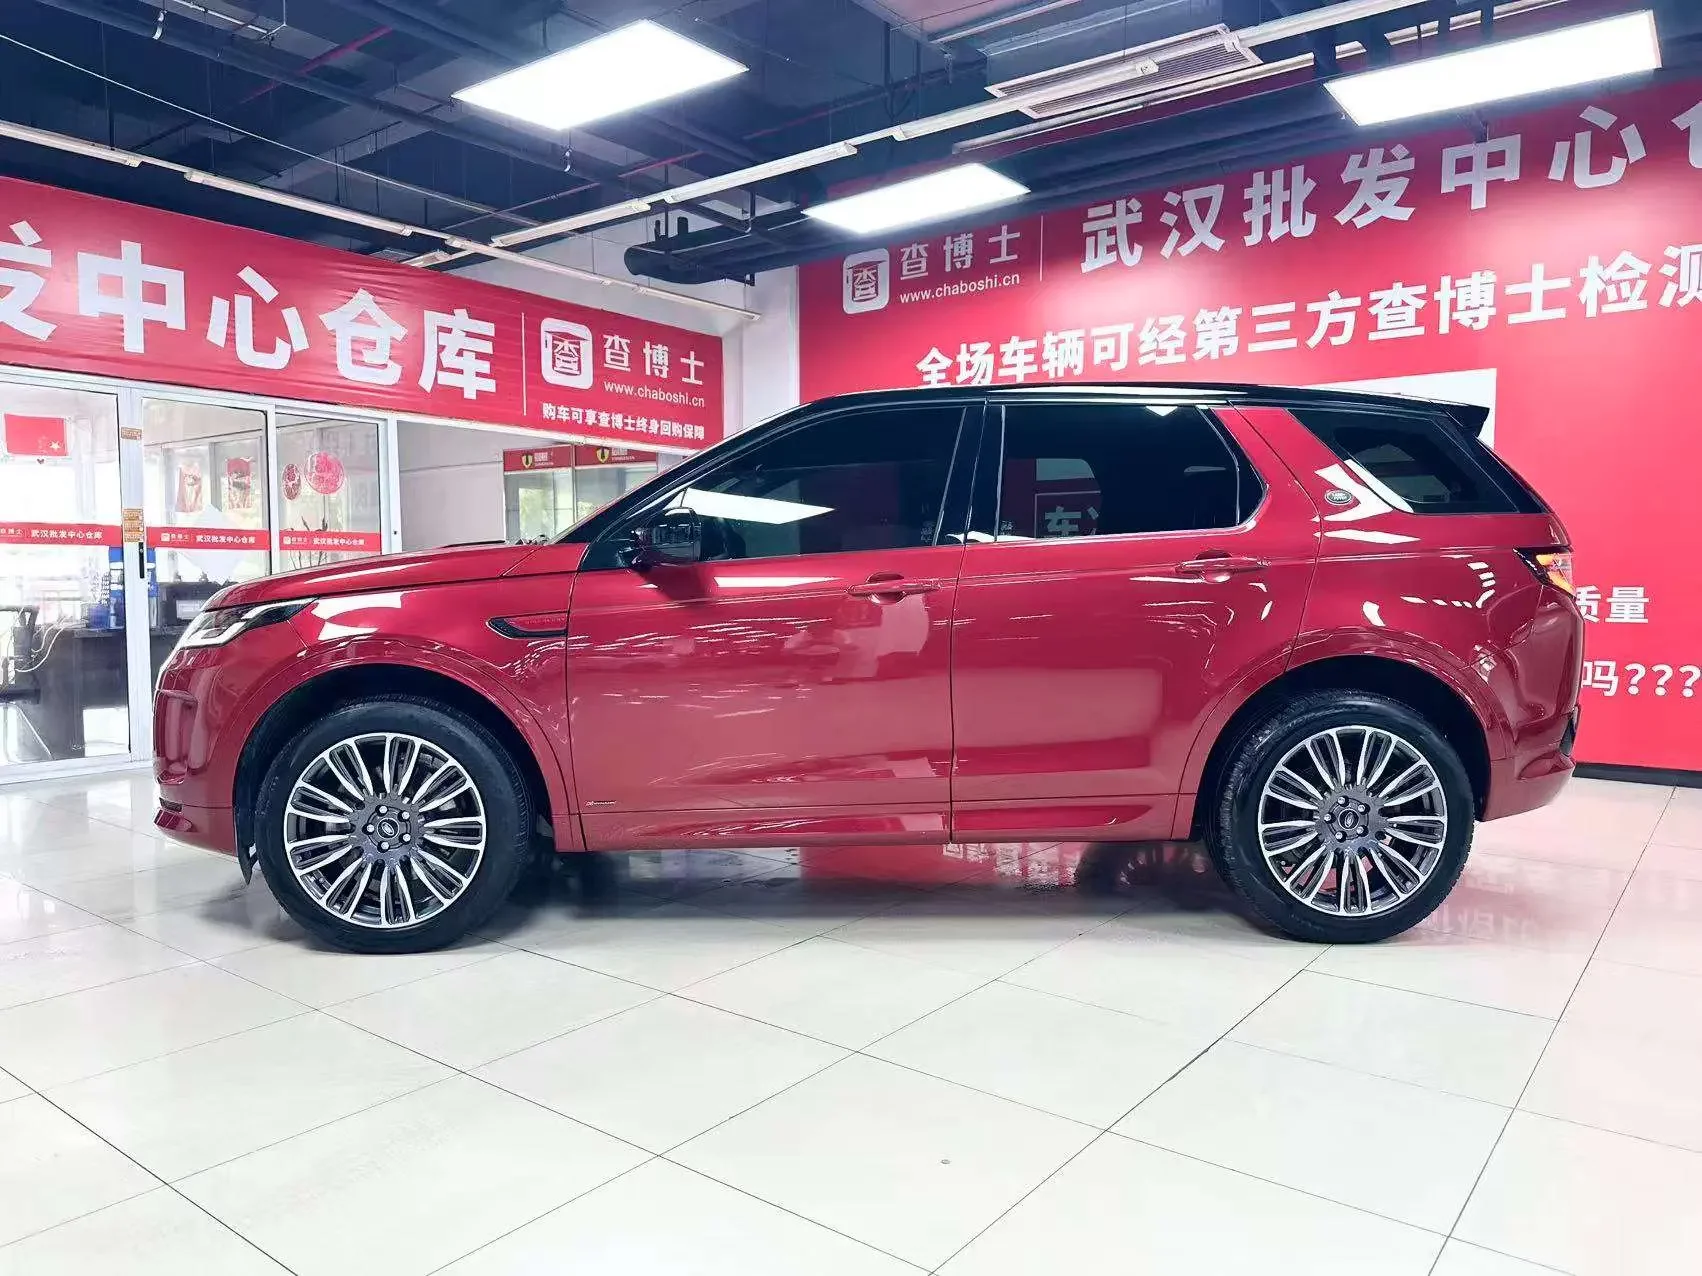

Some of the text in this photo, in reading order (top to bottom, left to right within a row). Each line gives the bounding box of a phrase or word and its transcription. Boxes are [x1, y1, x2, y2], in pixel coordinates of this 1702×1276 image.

[900, 225, 1021, 280] 查博士
[900, 273, 1020, 303] www.chaboshi.cn
[603, 335, 704, 385] 查博士
[604, 381, 705, 408] www.chaboshi.cn
[542, 402, 705, 441] 购车可享查博士终身回购保障
[1575, 584, 1650, 624] 质量
